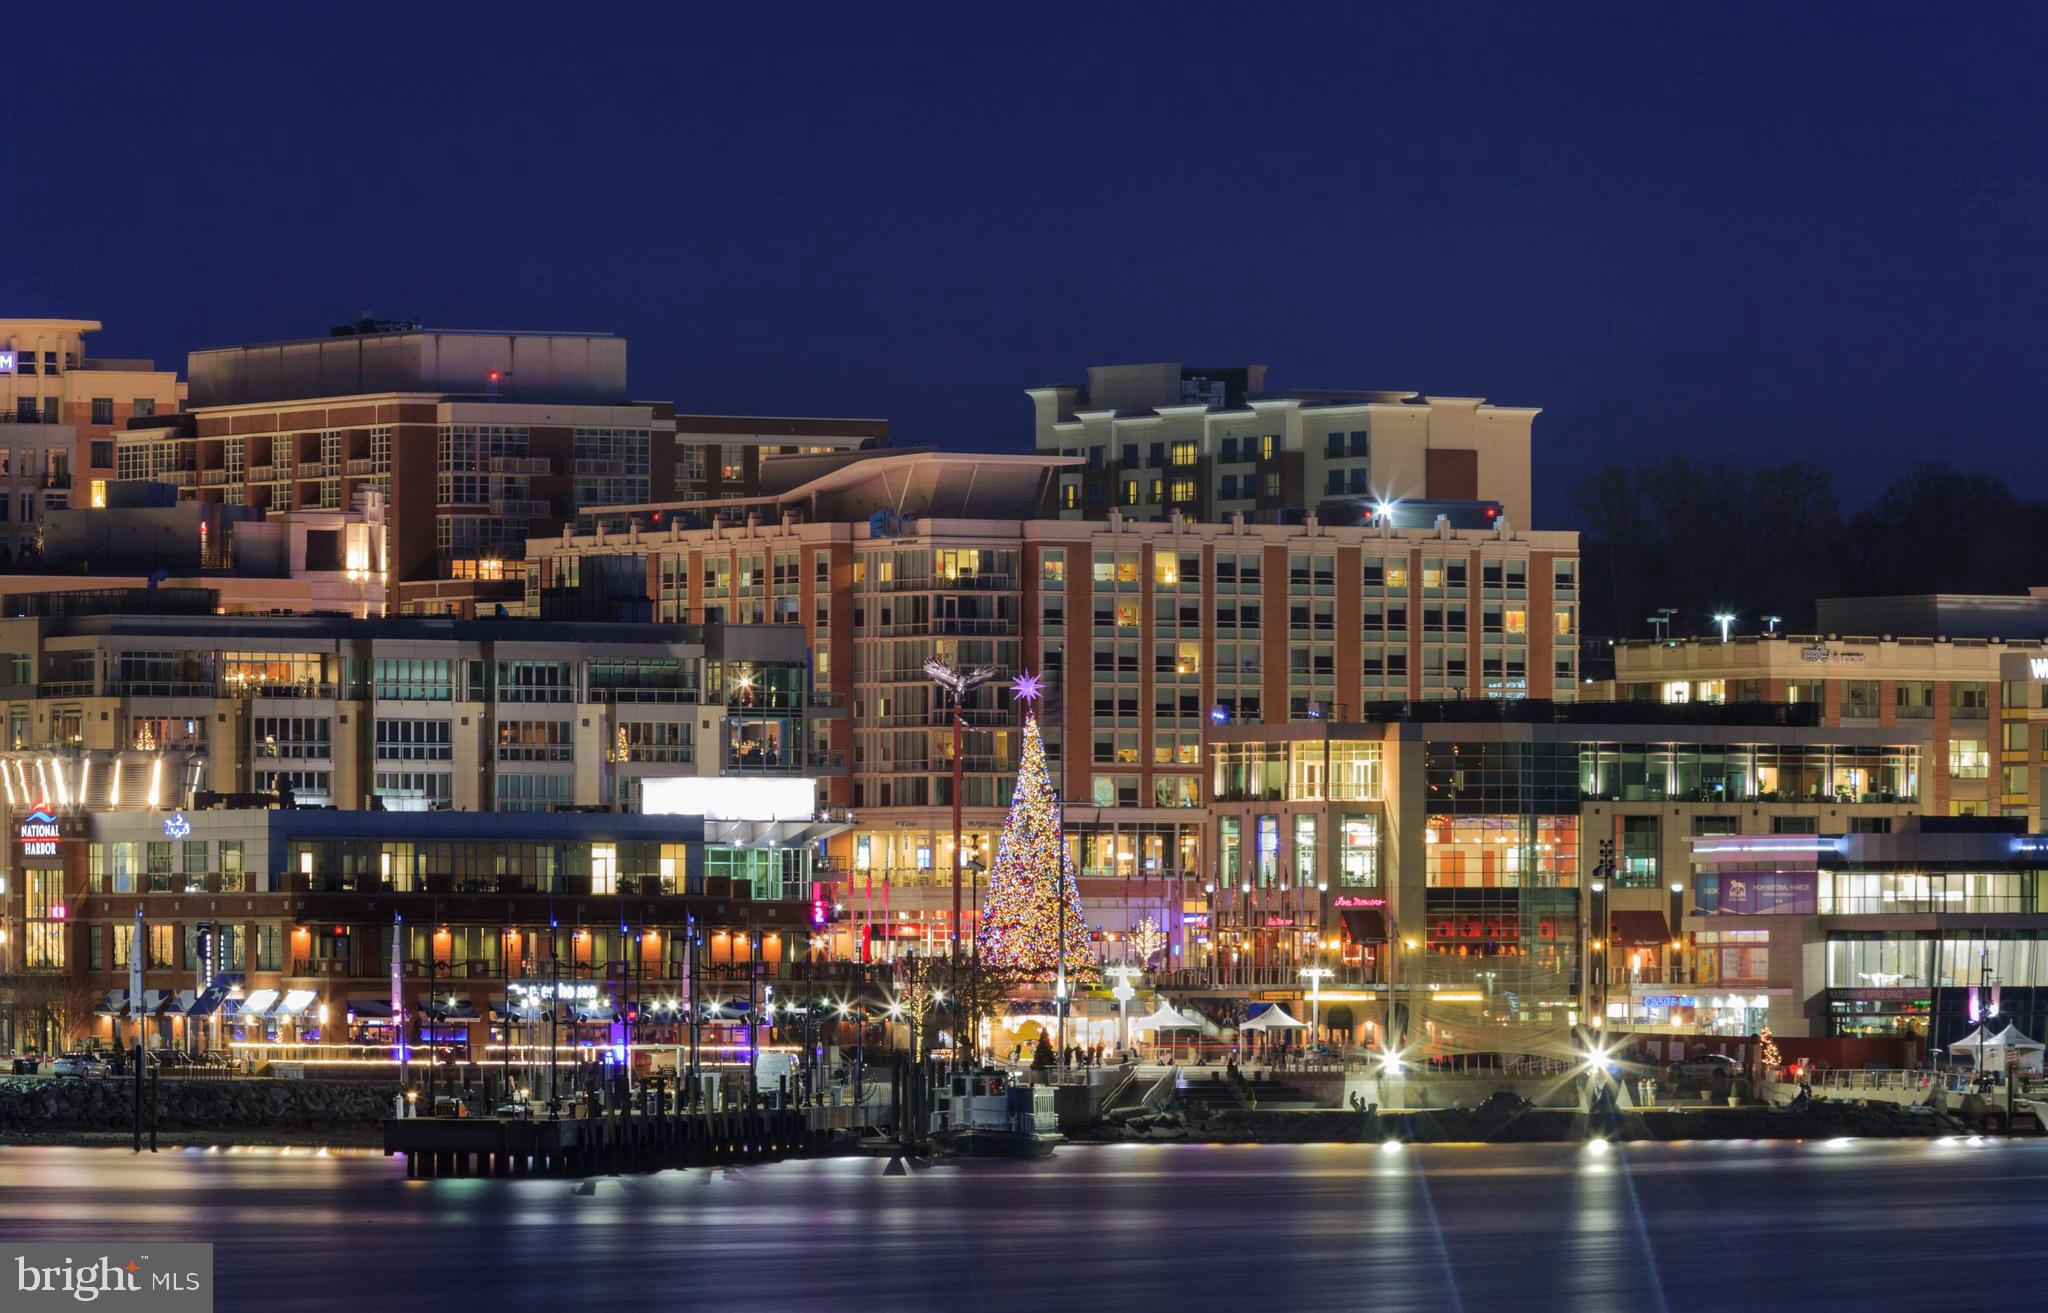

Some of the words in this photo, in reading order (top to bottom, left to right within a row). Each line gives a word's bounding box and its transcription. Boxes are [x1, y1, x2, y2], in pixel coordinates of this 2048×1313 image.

[21, 825, 60, 837] NATIONAL
[25, 842, 57, 855] HARBOR
[1644, 997, 1677, 1008] ONSITE
